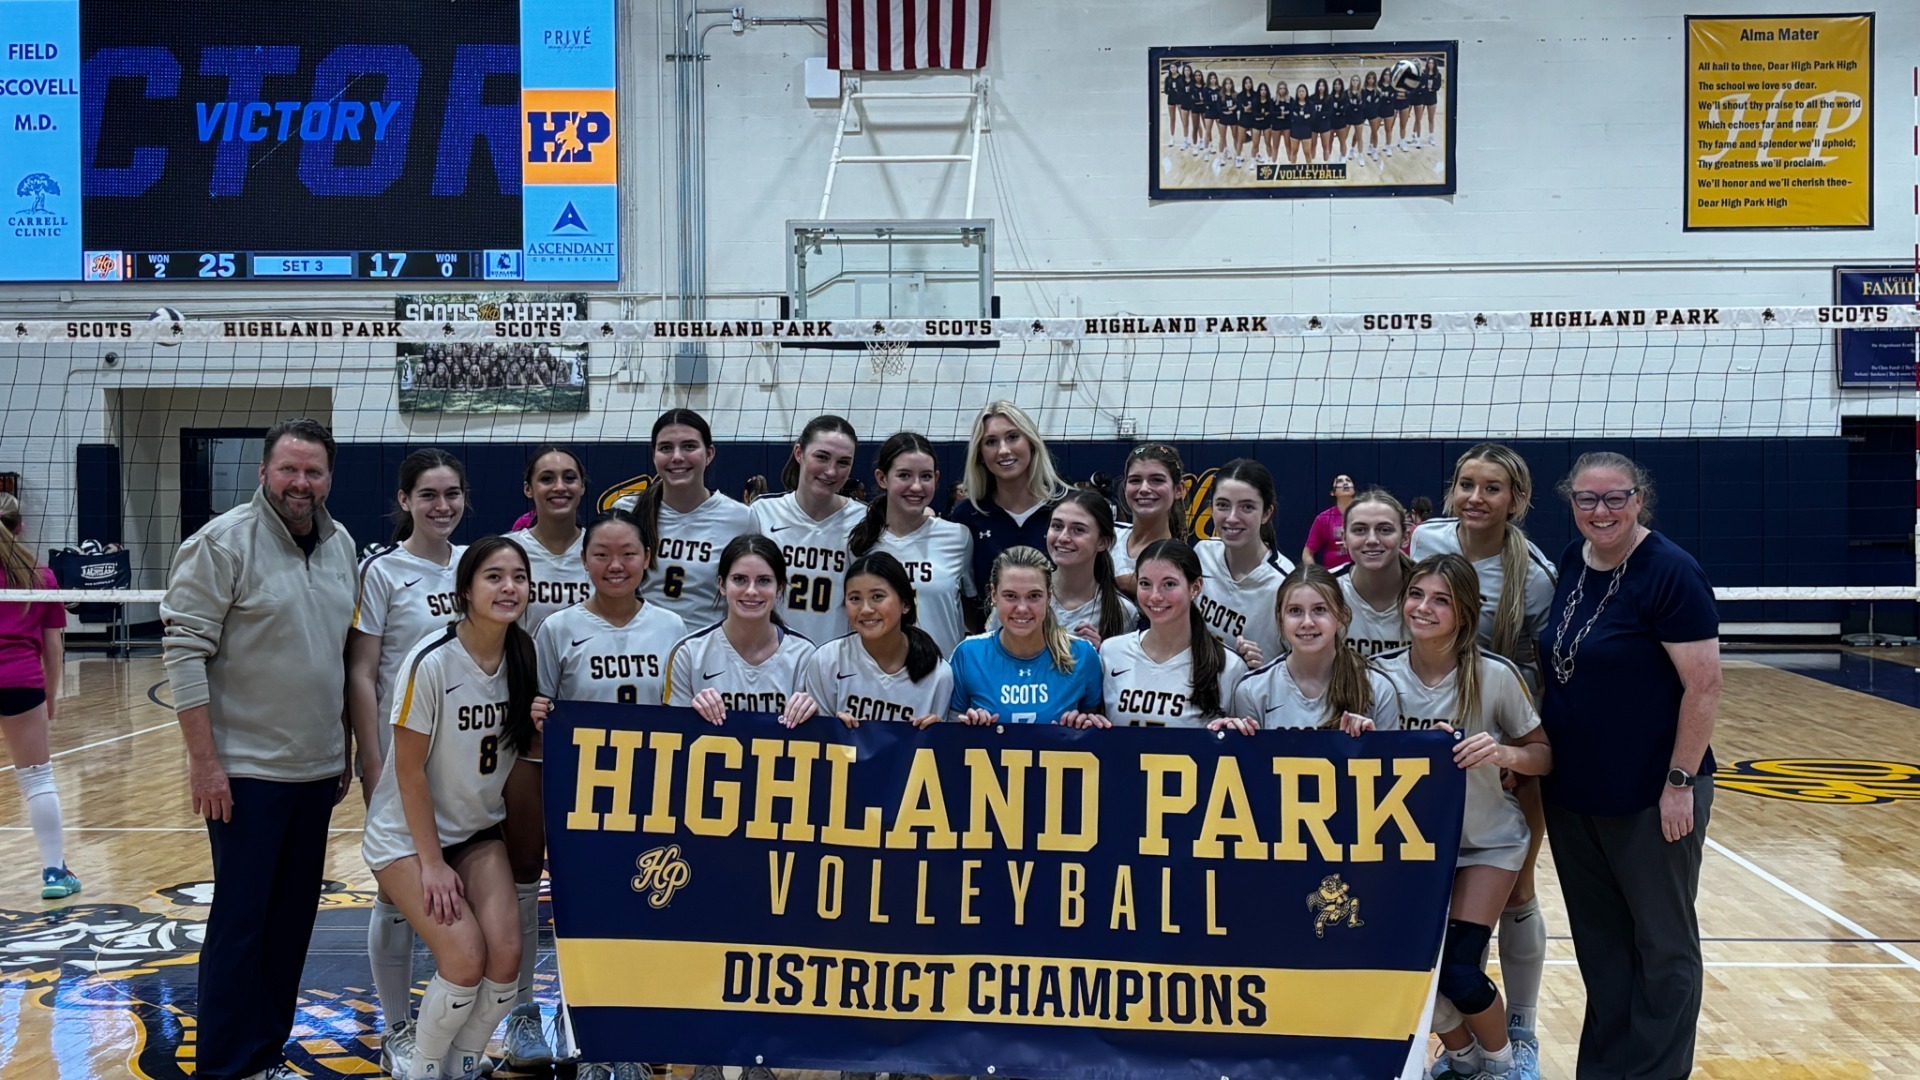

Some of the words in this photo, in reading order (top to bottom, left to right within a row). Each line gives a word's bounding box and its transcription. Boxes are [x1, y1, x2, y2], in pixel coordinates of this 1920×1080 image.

[544, 26, 592, 45] PRIVÉ
[1740, 28, 1775, 42] Alma
[1778, 27, 1819, 41] Mater
[8, 43, 58, 60] FIELD
[1698, 62, 1711, 71] All
[1731, 62, 1741, 71] to
[1767, 61, 1789, 70] Dear
[1791, 60, 1812, 72] High
[1813, 60, 1835, 70] Park
[1836, 60, 1858, 71] High
[0, 78, 79, 96] SCOVELL
[1698, 81, 1714, 91] The
[1716, 81, 1746, 91] school
[1761, 81, 1780, 90] love
[1781, 82, 1792, 90] so
[1722, 100, 1748, 110] shout
[1749, 100, 1763, 111] thy
[1765, 100, 1793, 111] praise
[1795, 100, 1804, 109] to
[1806, 99, 1818, 109] all
[1820, 99, 1835, 109] the
[1836, 98, 1861, 108] world
[14, 113, 58, 131] M.D.
[196, 101, 401, 142] VICTORY
[1698, 120, 1726, 130] Which
[1762, 119, 1775, 129] far
[1776, 119, 1794, 129] and
[1698, 140, 1713, 151] Thy
[1714, 139, 1737, 149] fame
[1739, 139, 1757, 149] and
[1758, 139, 1798, 150] splendor
[1698, 159, 1713, 170] Thy
[1714, 160, 1759, 170] greatness
[1783, 159, 1827, 170] proclaim.
[1279, 169, 1346, 180] VOLLEYBALL
[1722, 179, 1748, 188] honor
[1749, 178, 1767, 188] and
[1791, 177, 1825, 187] cherish
[1697, 198, 1719, 208] Dear
[1721, 198, 1742, 209] High
[1744, 198, 1765, 207] Park
[1766, 197, 1788, 208] High
[8, 216, 69, 226] CARRELL
[15, 227, 61, 237] CLINIC
[528, 242, 615, 255] ASCENDANT
[148, 254, 170, 263] WON
[198, 253, 236, 278] 25
[282, 260, 307, 272] SET
[311, 259, 324, 272] 3
[369, 252, 407, 278] 17
[435, 253, 458, 263] WON
[154, 263, 166, 279] 2
[441, 262, 453, 278] 0
[405, 303, 480, 321] SCOTS
[500, 302, 578, 321] CHEER
[1530, 310, 1646, 327] HIGHLAND
[1655, 308, 1720, 325] PARK
[1818, 306, 1888, 323] SCOTS
[67, 322, 132, 338] SCOTS
[223, 322, 333, 337] HIGHLAND
[342, 321, 403, 338] PARK
[494, 321, 562, 338] SCOTS
[653, 321, 763, 337] HIGHLAND
[772, 320, 833, 337] PARK
[925, 319, 992, 336] SCOTS
[1085, 317, 1196, 334] HIGHLAND
[1206, 316, 1268, 333] PARK
[1363, 314, 1433, 330] SCOTS
[657, 537, 713, 563] COTS
[783, 544, 846, 573] SCOTS
[664, 565, 685, 599] 6
[787, 573, 834, 614] 20
[426, 591, 462, 617] SCO
[1199, 594, 1247, 638] SCOTS
[590, 653, 660, 680] SCOTS
[1000, 682, 1049, 705] SCOTS
[1117, 688, 1186, 717] SCOTS
[457, 701, 509, 732] SCOT
[479, 733, 499, 776] 8
[566, 727, 1100, 853] HIGHLAND
[1138, 752, 1436, 863] PARK
[631, 843, 691, 909] HP
[768, 850, 1228, 936] VOLLEYBALL
[721, 949, 956, 1014] DISTRICT
[967, 961, 1269, 1028] CHAMPIONS
